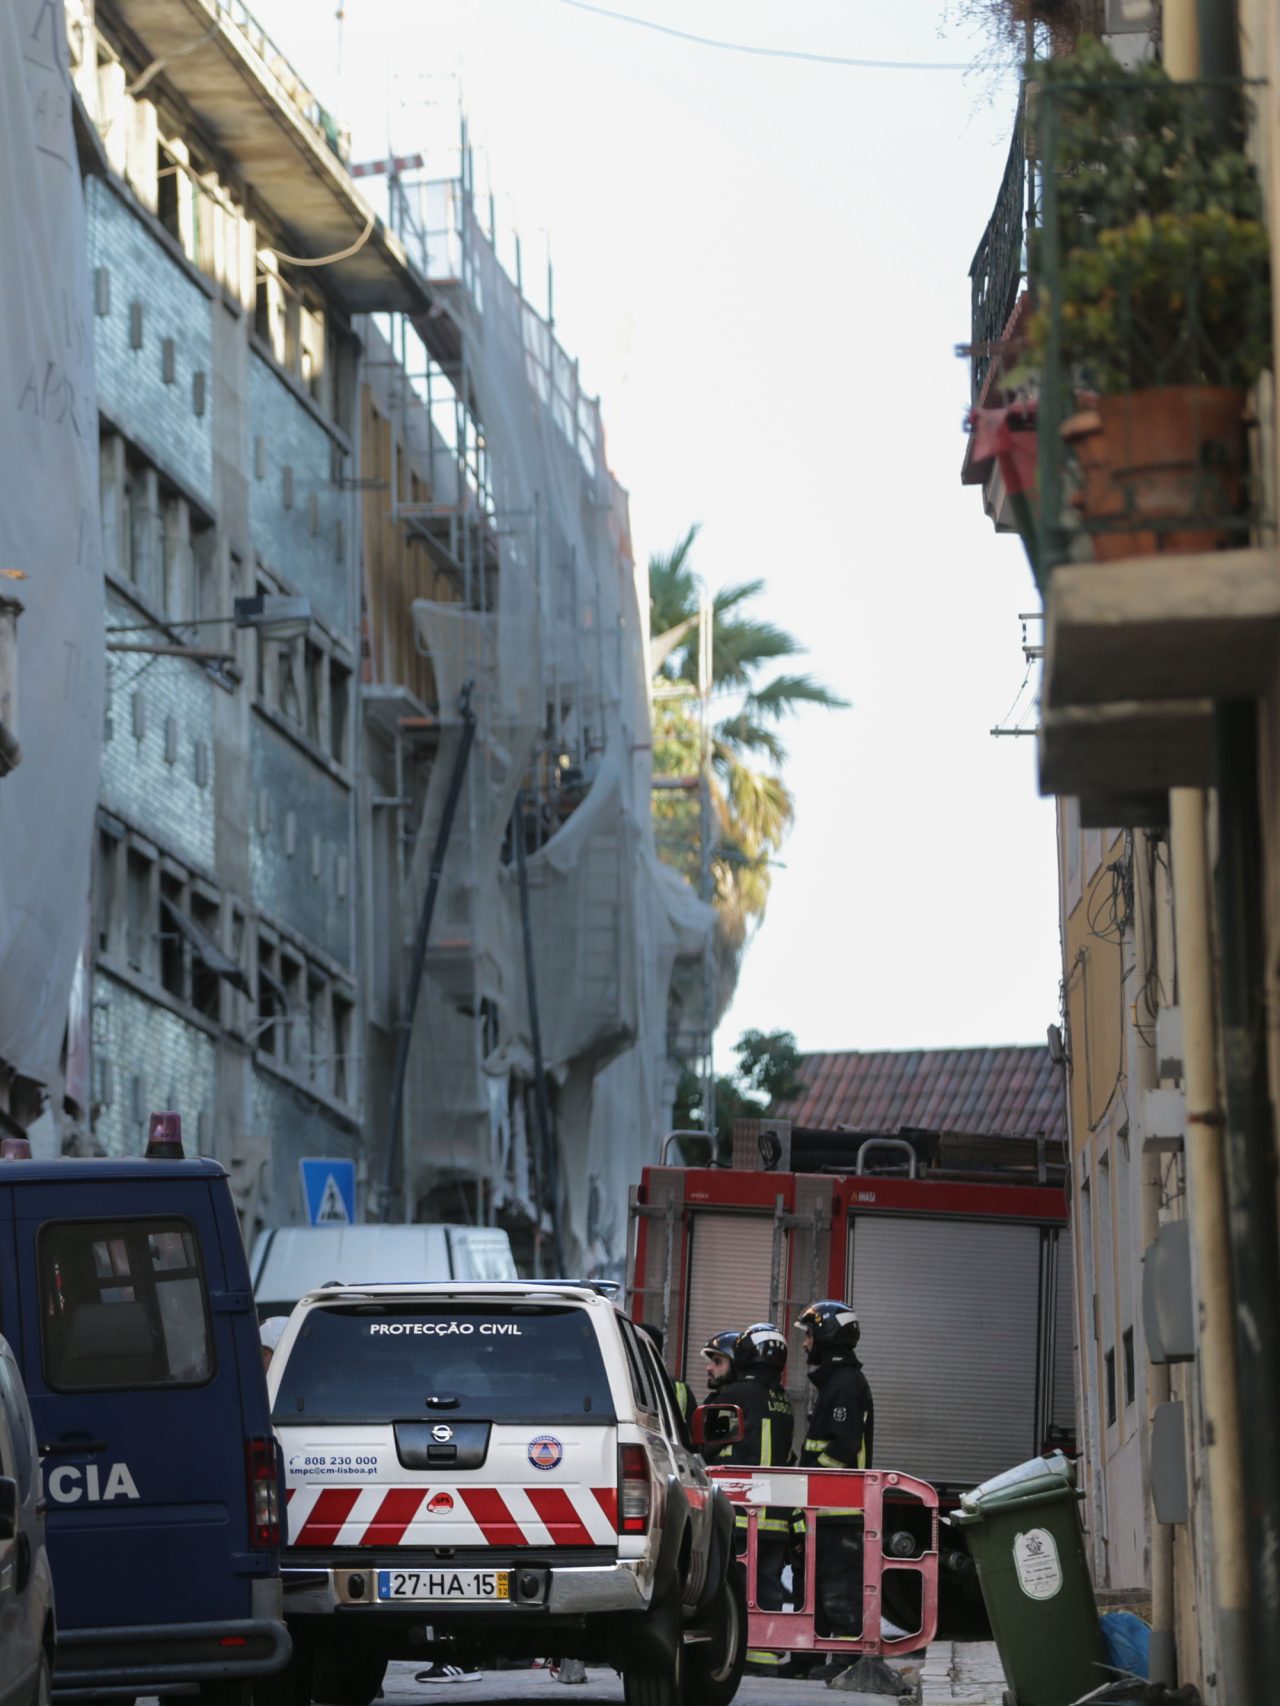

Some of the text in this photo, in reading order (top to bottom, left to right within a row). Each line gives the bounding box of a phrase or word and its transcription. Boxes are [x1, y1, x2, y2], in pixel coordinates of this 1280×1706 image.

[370, 1322, 522, 1336] PROTECÇÃO CIVIL
[304, 1456, 378, 1466] 808 230 000
